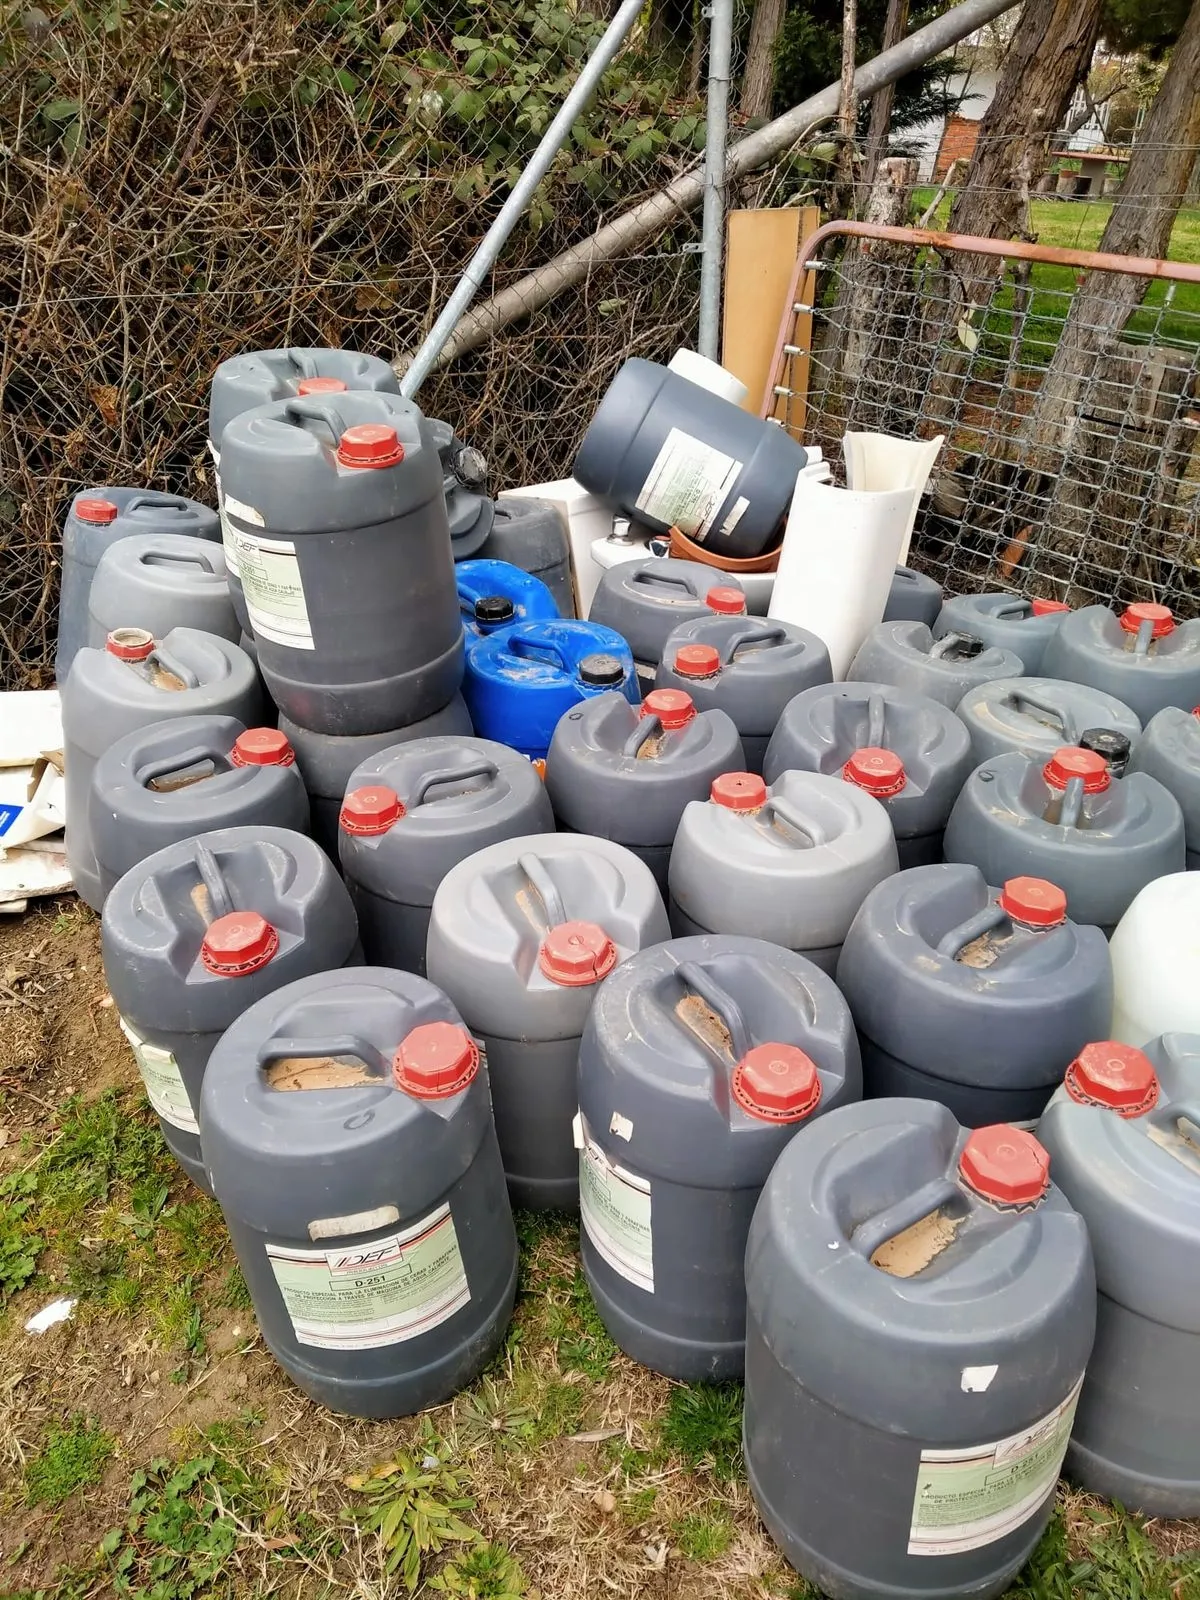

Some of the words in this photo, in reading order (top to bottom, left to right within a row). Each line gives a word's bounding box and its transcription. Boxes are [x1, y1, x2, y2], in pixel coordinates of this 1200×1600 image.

[283, 1286, 310, 1296] PRODUCTO
[363, 1281, 400, 1293] ELIMINACION
[409, 1268, 427, 1280] CERAS
[432, 1244, 457, 1265] PARAFINAS
[376, 1285, 402, 1295] MAQUINA
[428, 1256, 450, 1274] CALIENTE
[355, 1275, 386, 1287] D-251
[945, 1492, 984, 1503] PROTECCION
[958, 1487, 987, 1497] ESPECIAL
